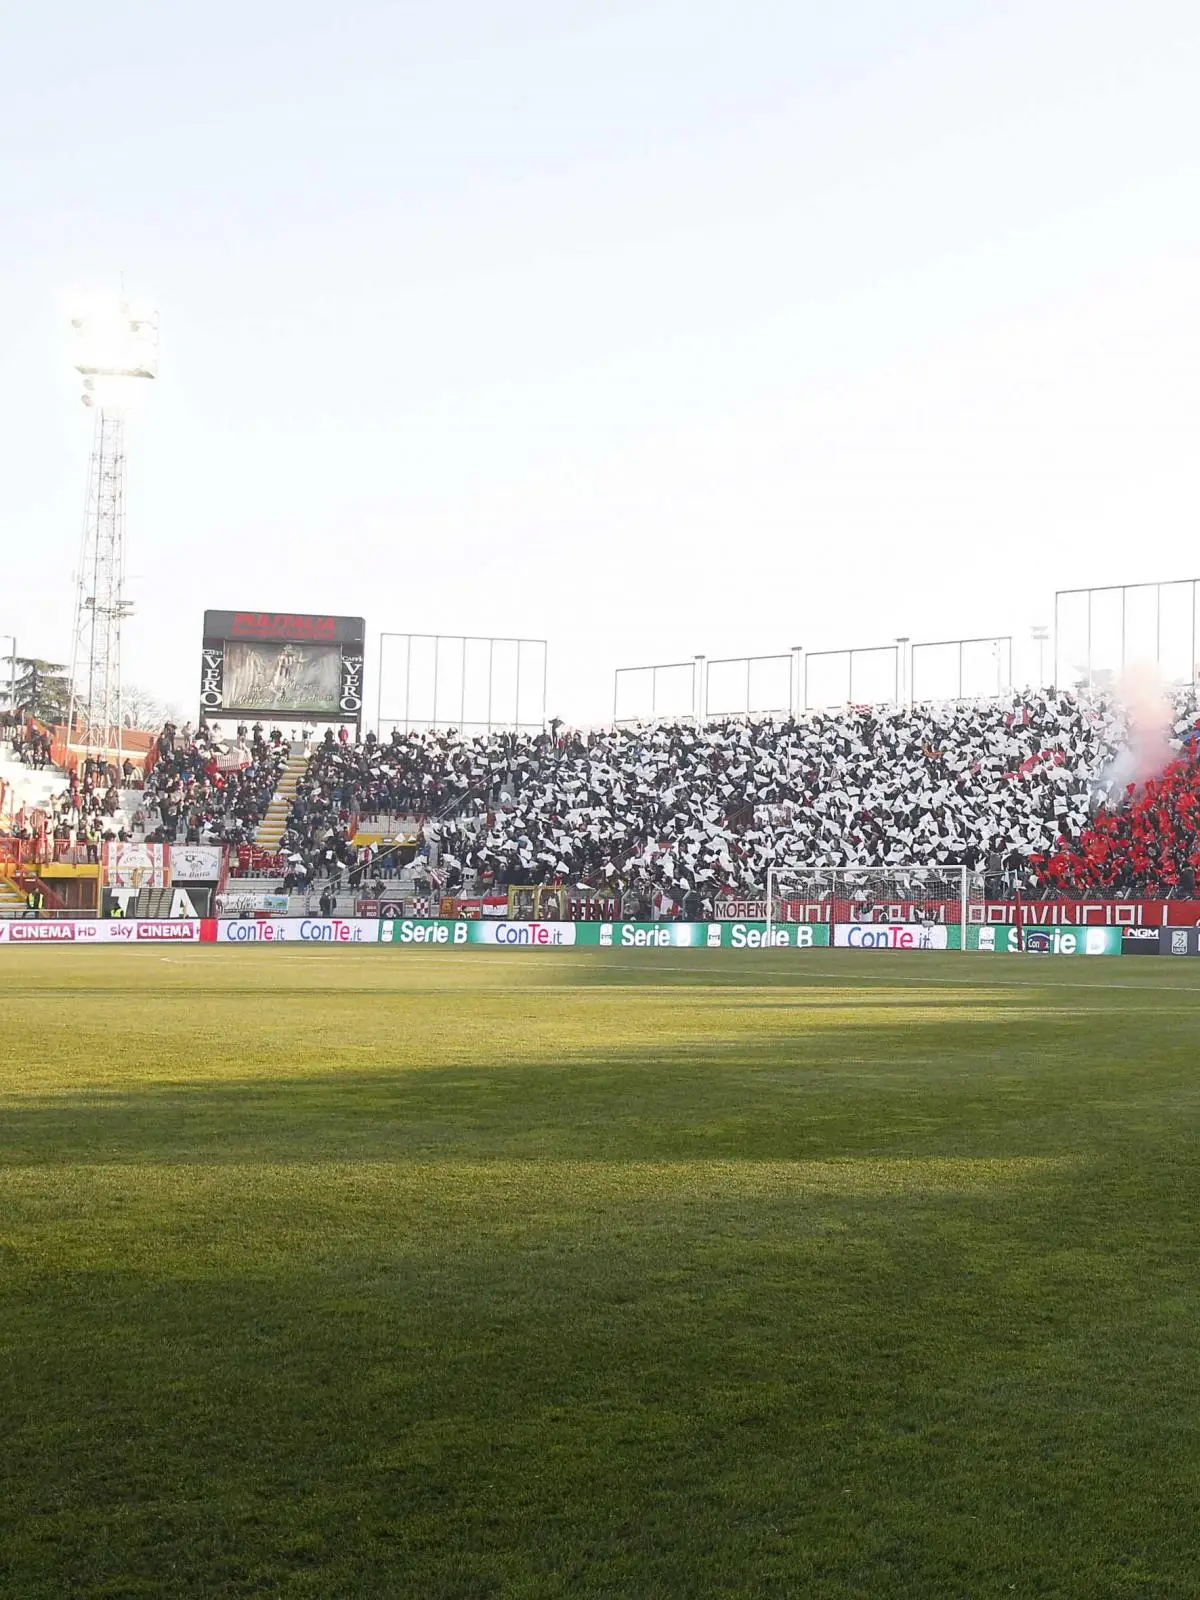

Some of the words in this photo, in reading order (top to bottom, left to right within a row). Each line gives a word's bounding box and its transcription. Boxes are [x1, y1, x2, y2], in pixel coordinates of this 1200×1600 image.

[200, 655, 223, 706] VERO
[340, 661, 363, 711] VERO
[12, 925, 72, 938] CINEMA
[78, 927, 96, 936] HD
[110, 925, 133, 938] sky
[139, 925, 191, 937] CINEMA
[227, 921, 285, 941] ConTe.it
[300, 920, 361, 941] ConTe.it
[400, 920, 449, 943] Serie
[454, 922, 468, 944] B
[495, 923, 562, 945] ConTe.it
[621, 924, 670, 946] Serie
[731, 924, 790, 948] Serie
[797, 925, 813, 948] B
[1007, 927, 1077, 954] Srie
[1127, 928, 1160, 938] NGM
